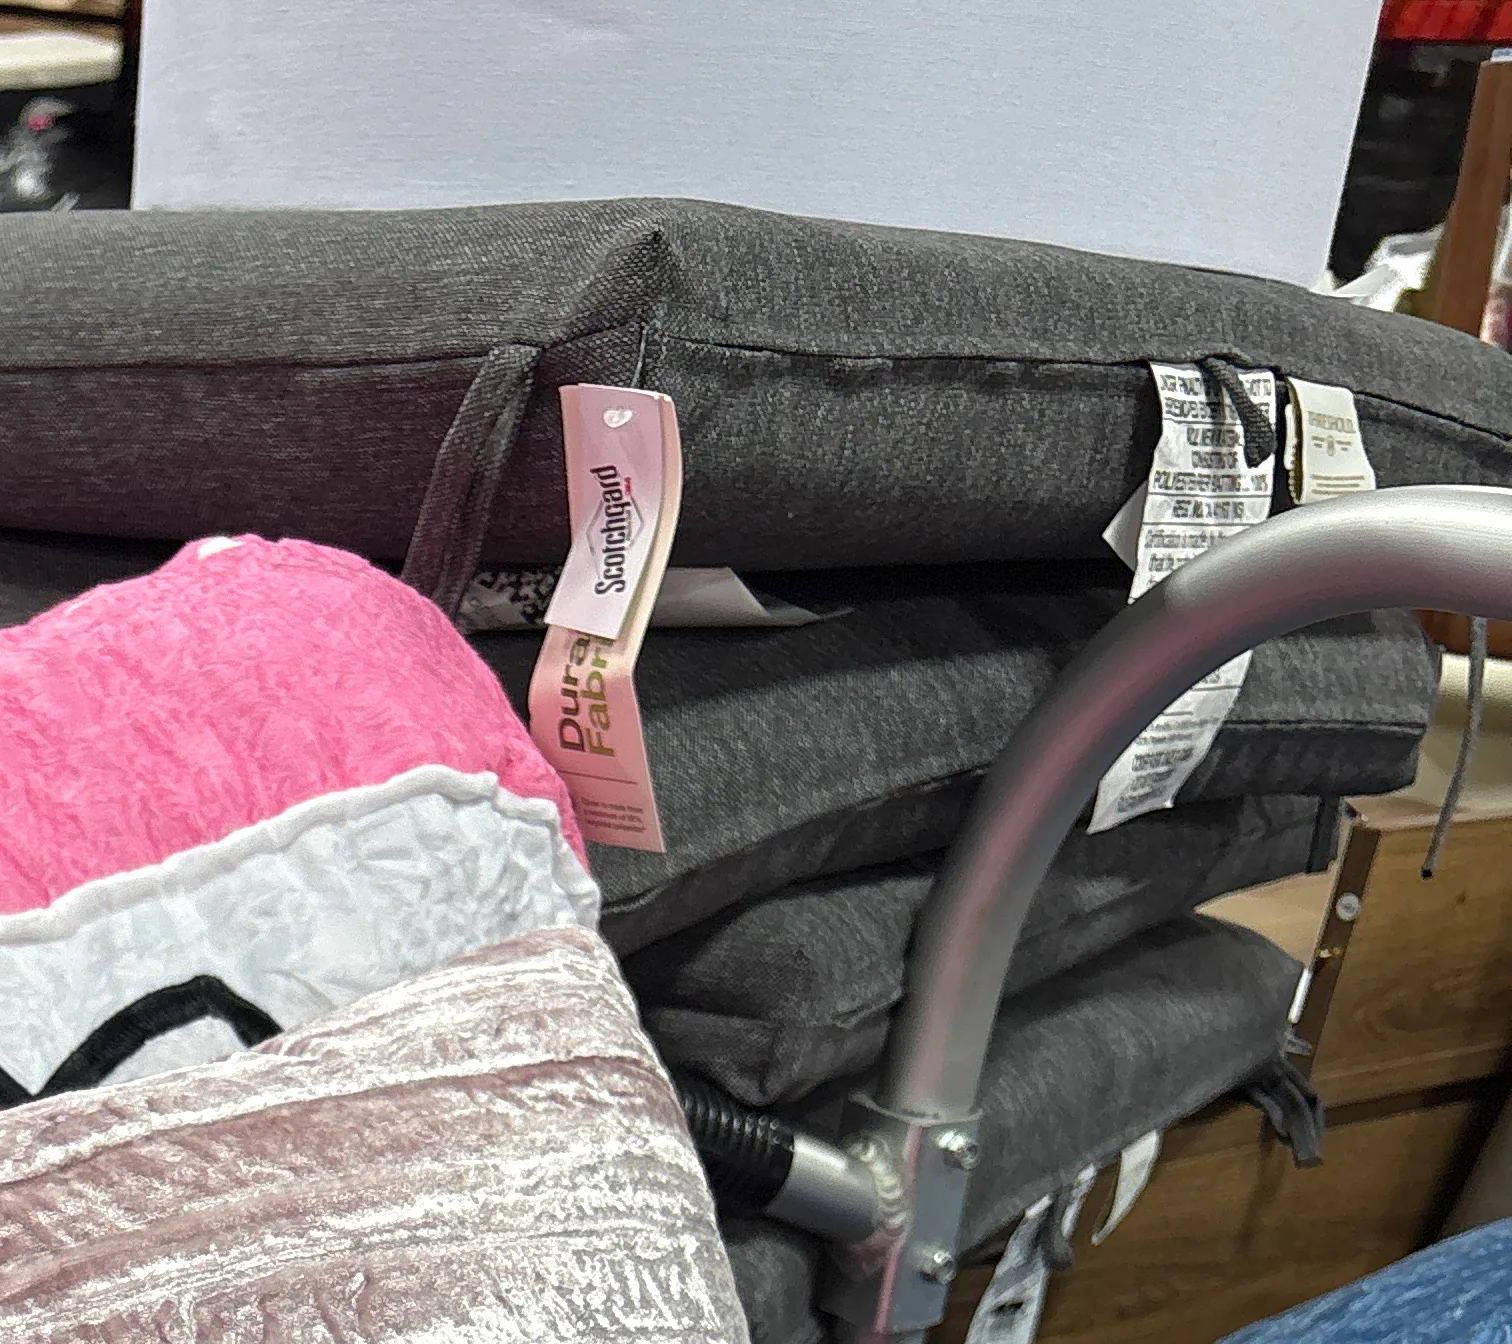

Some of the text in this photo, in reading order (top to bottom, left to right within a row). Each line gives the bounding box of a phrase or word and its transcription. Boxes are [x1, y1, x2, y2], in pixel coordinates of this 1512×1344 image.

[589, 464, 631, 595] Scotchgard
[558, 637, 590, 752] Dura
[581, 638, 615, 757] Fabri
